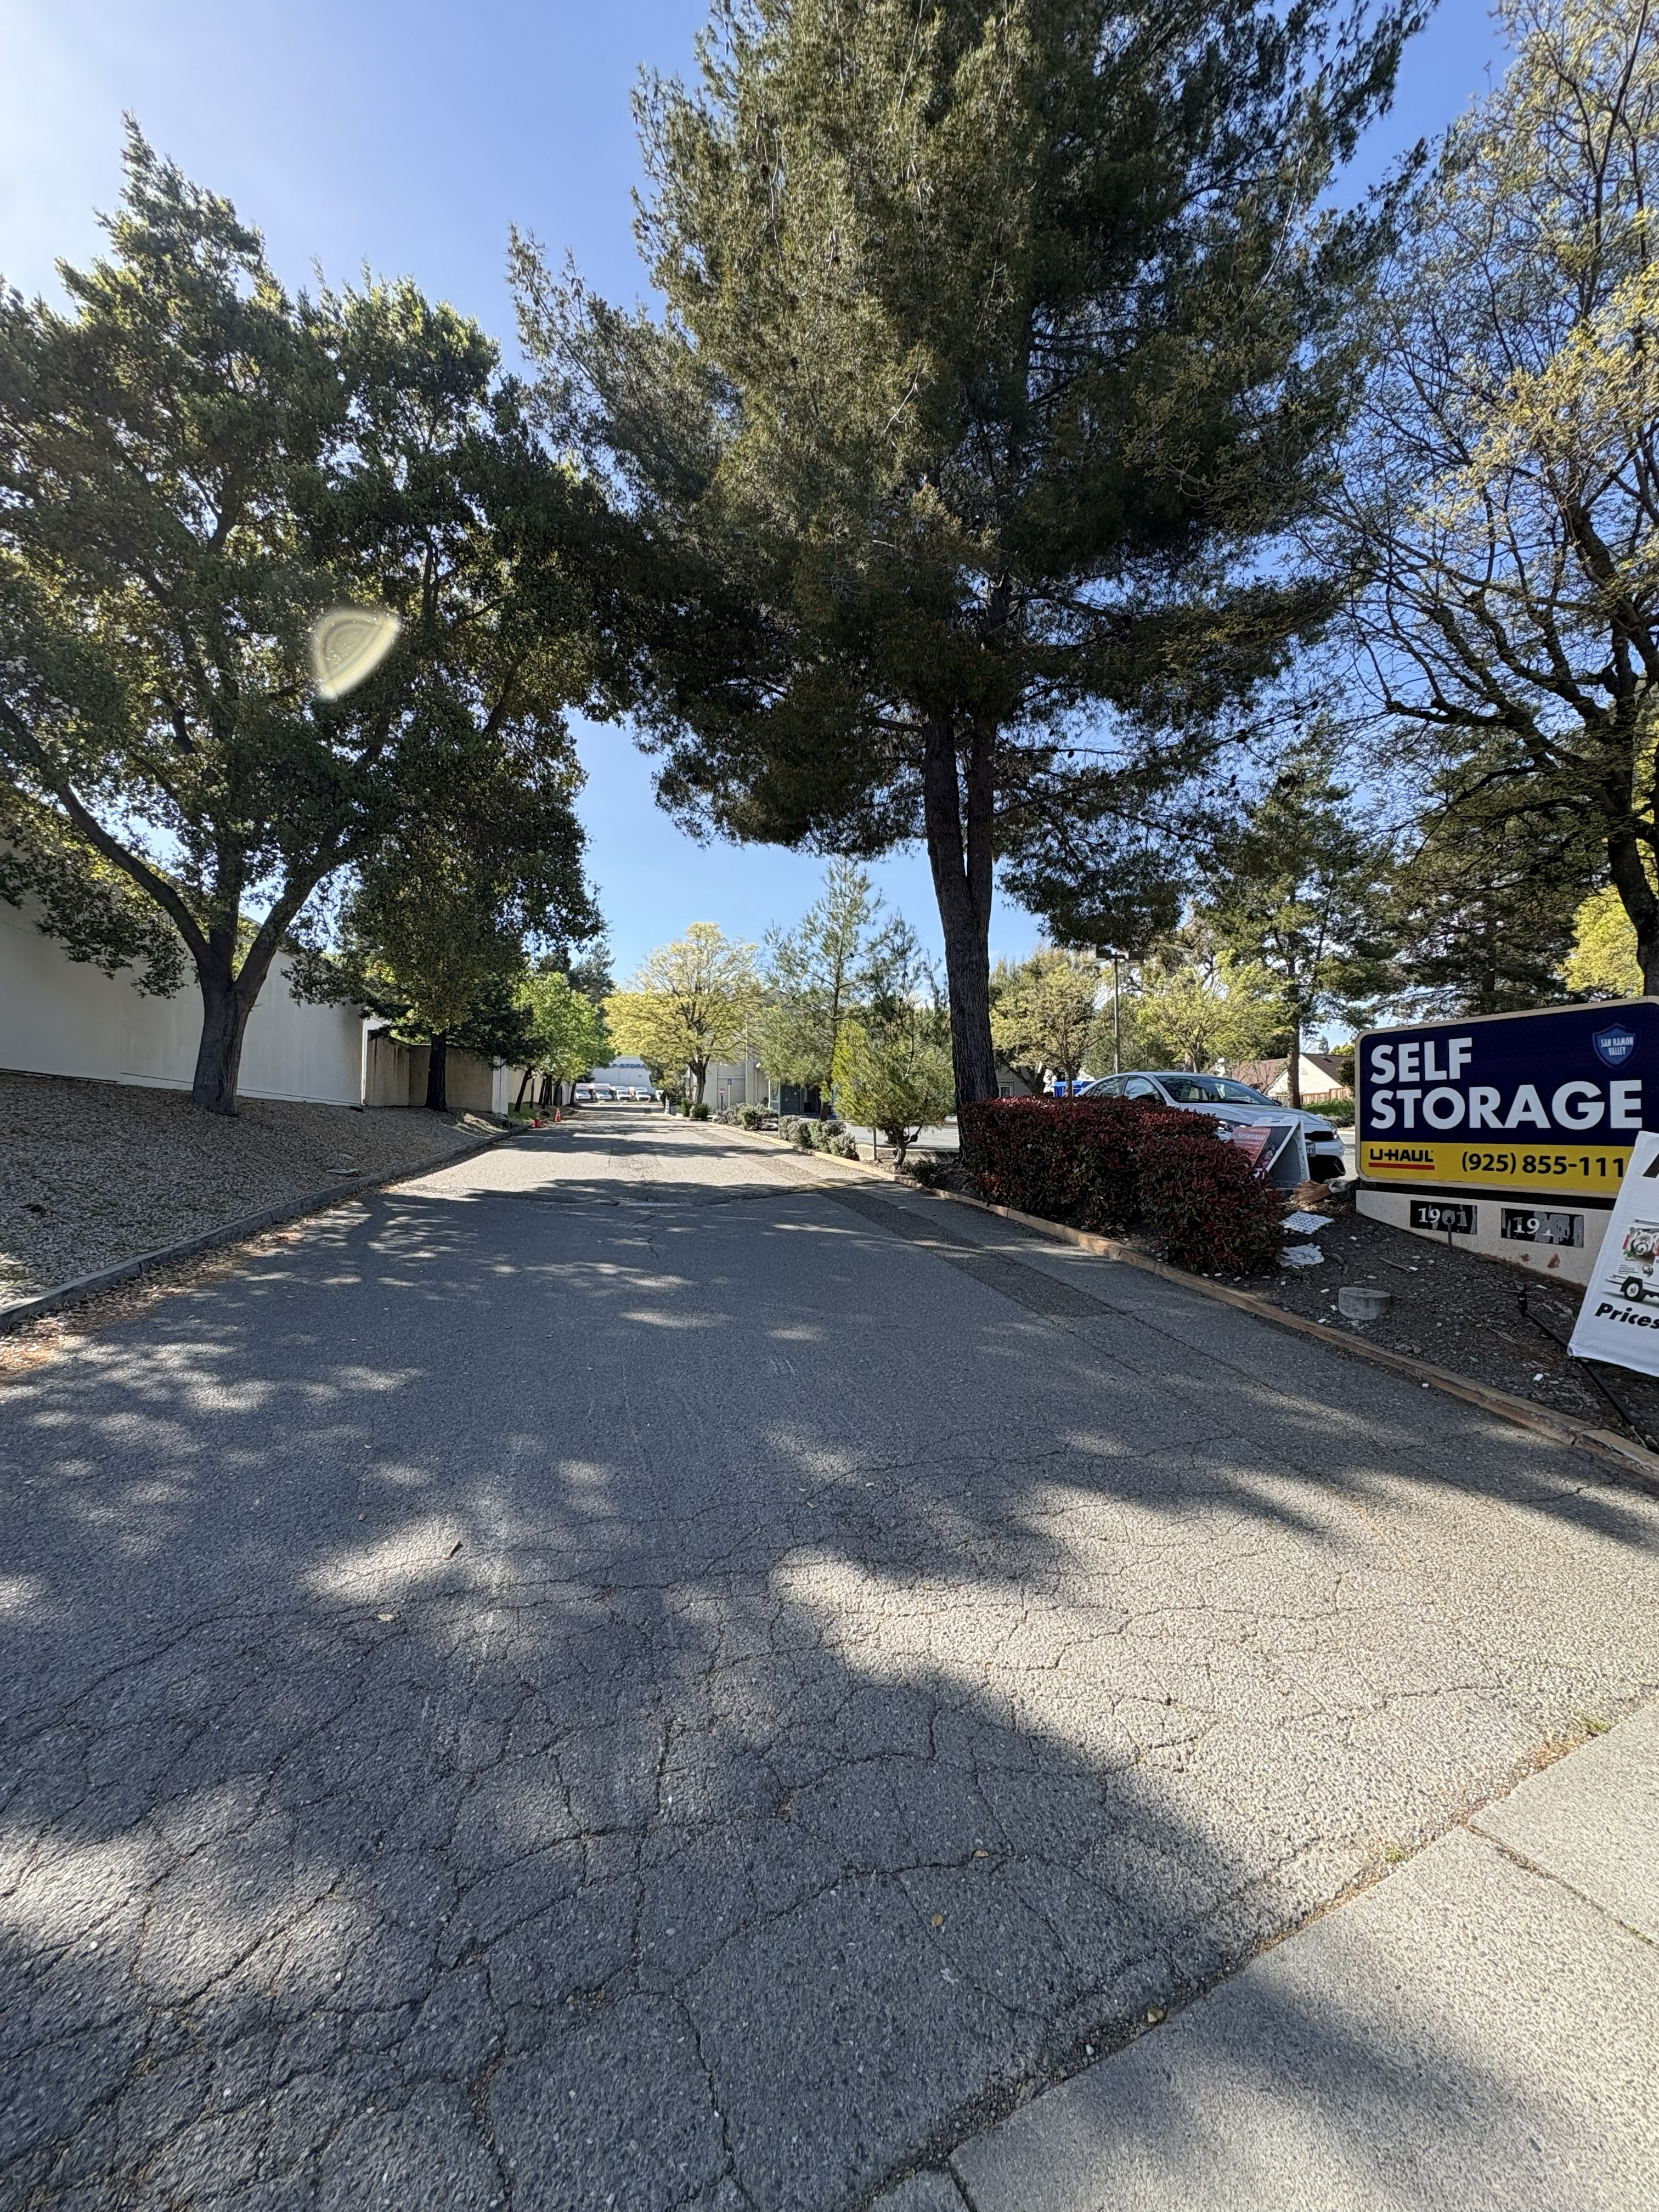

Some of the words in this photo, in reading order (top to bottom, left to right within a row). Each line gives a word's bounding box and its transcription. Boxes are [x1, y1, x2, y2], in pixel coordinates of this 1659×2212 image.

[1600, 1038, 1611, 1048] SAN
[1612, 1036, 1634, 1047] RAMON
[1608, 1046, 1626, 1056] VALLEY
[1370, 1037, 1472, 1085] SELF
[1370, 1080, 1643, 1130] STORAGE
[1369, 1148, 1434, 1163] U-HAUL
[1462, 1151, 1516, 1175] (925)
[1594, 1302, 1659, 1330] Prices
